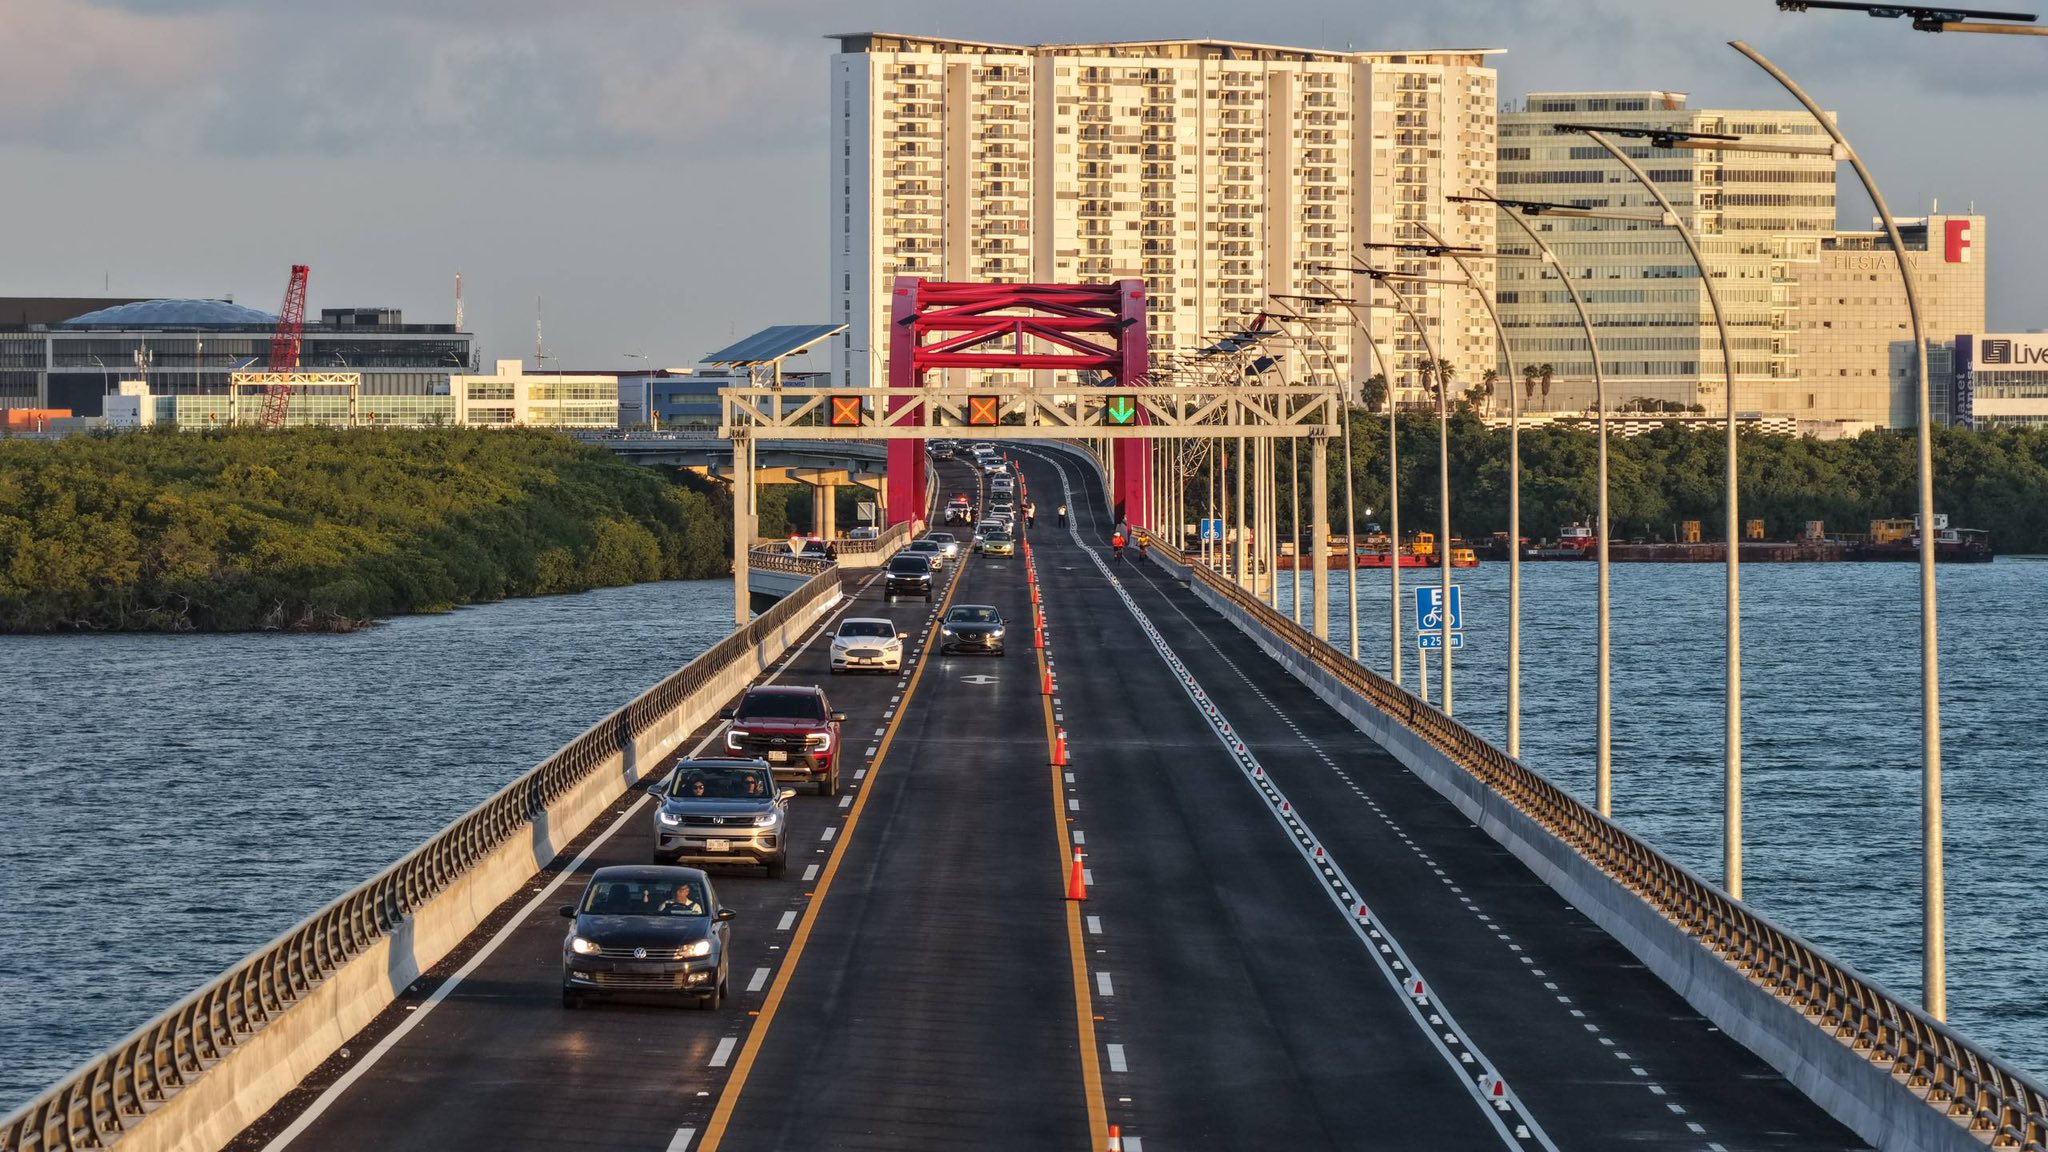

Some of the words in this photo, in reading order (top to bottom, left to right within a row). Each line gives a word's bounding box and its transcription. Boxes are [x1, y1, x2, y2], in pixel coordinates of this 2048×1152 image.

[1834, 255, 1887, 270] FIESTA
[1893, 255, 1919, 271] IN
[1965, 361, 1974, 423] fitness
[1422, 638, 1428, 646] a
[1430, 636, 1441, 646] 25
